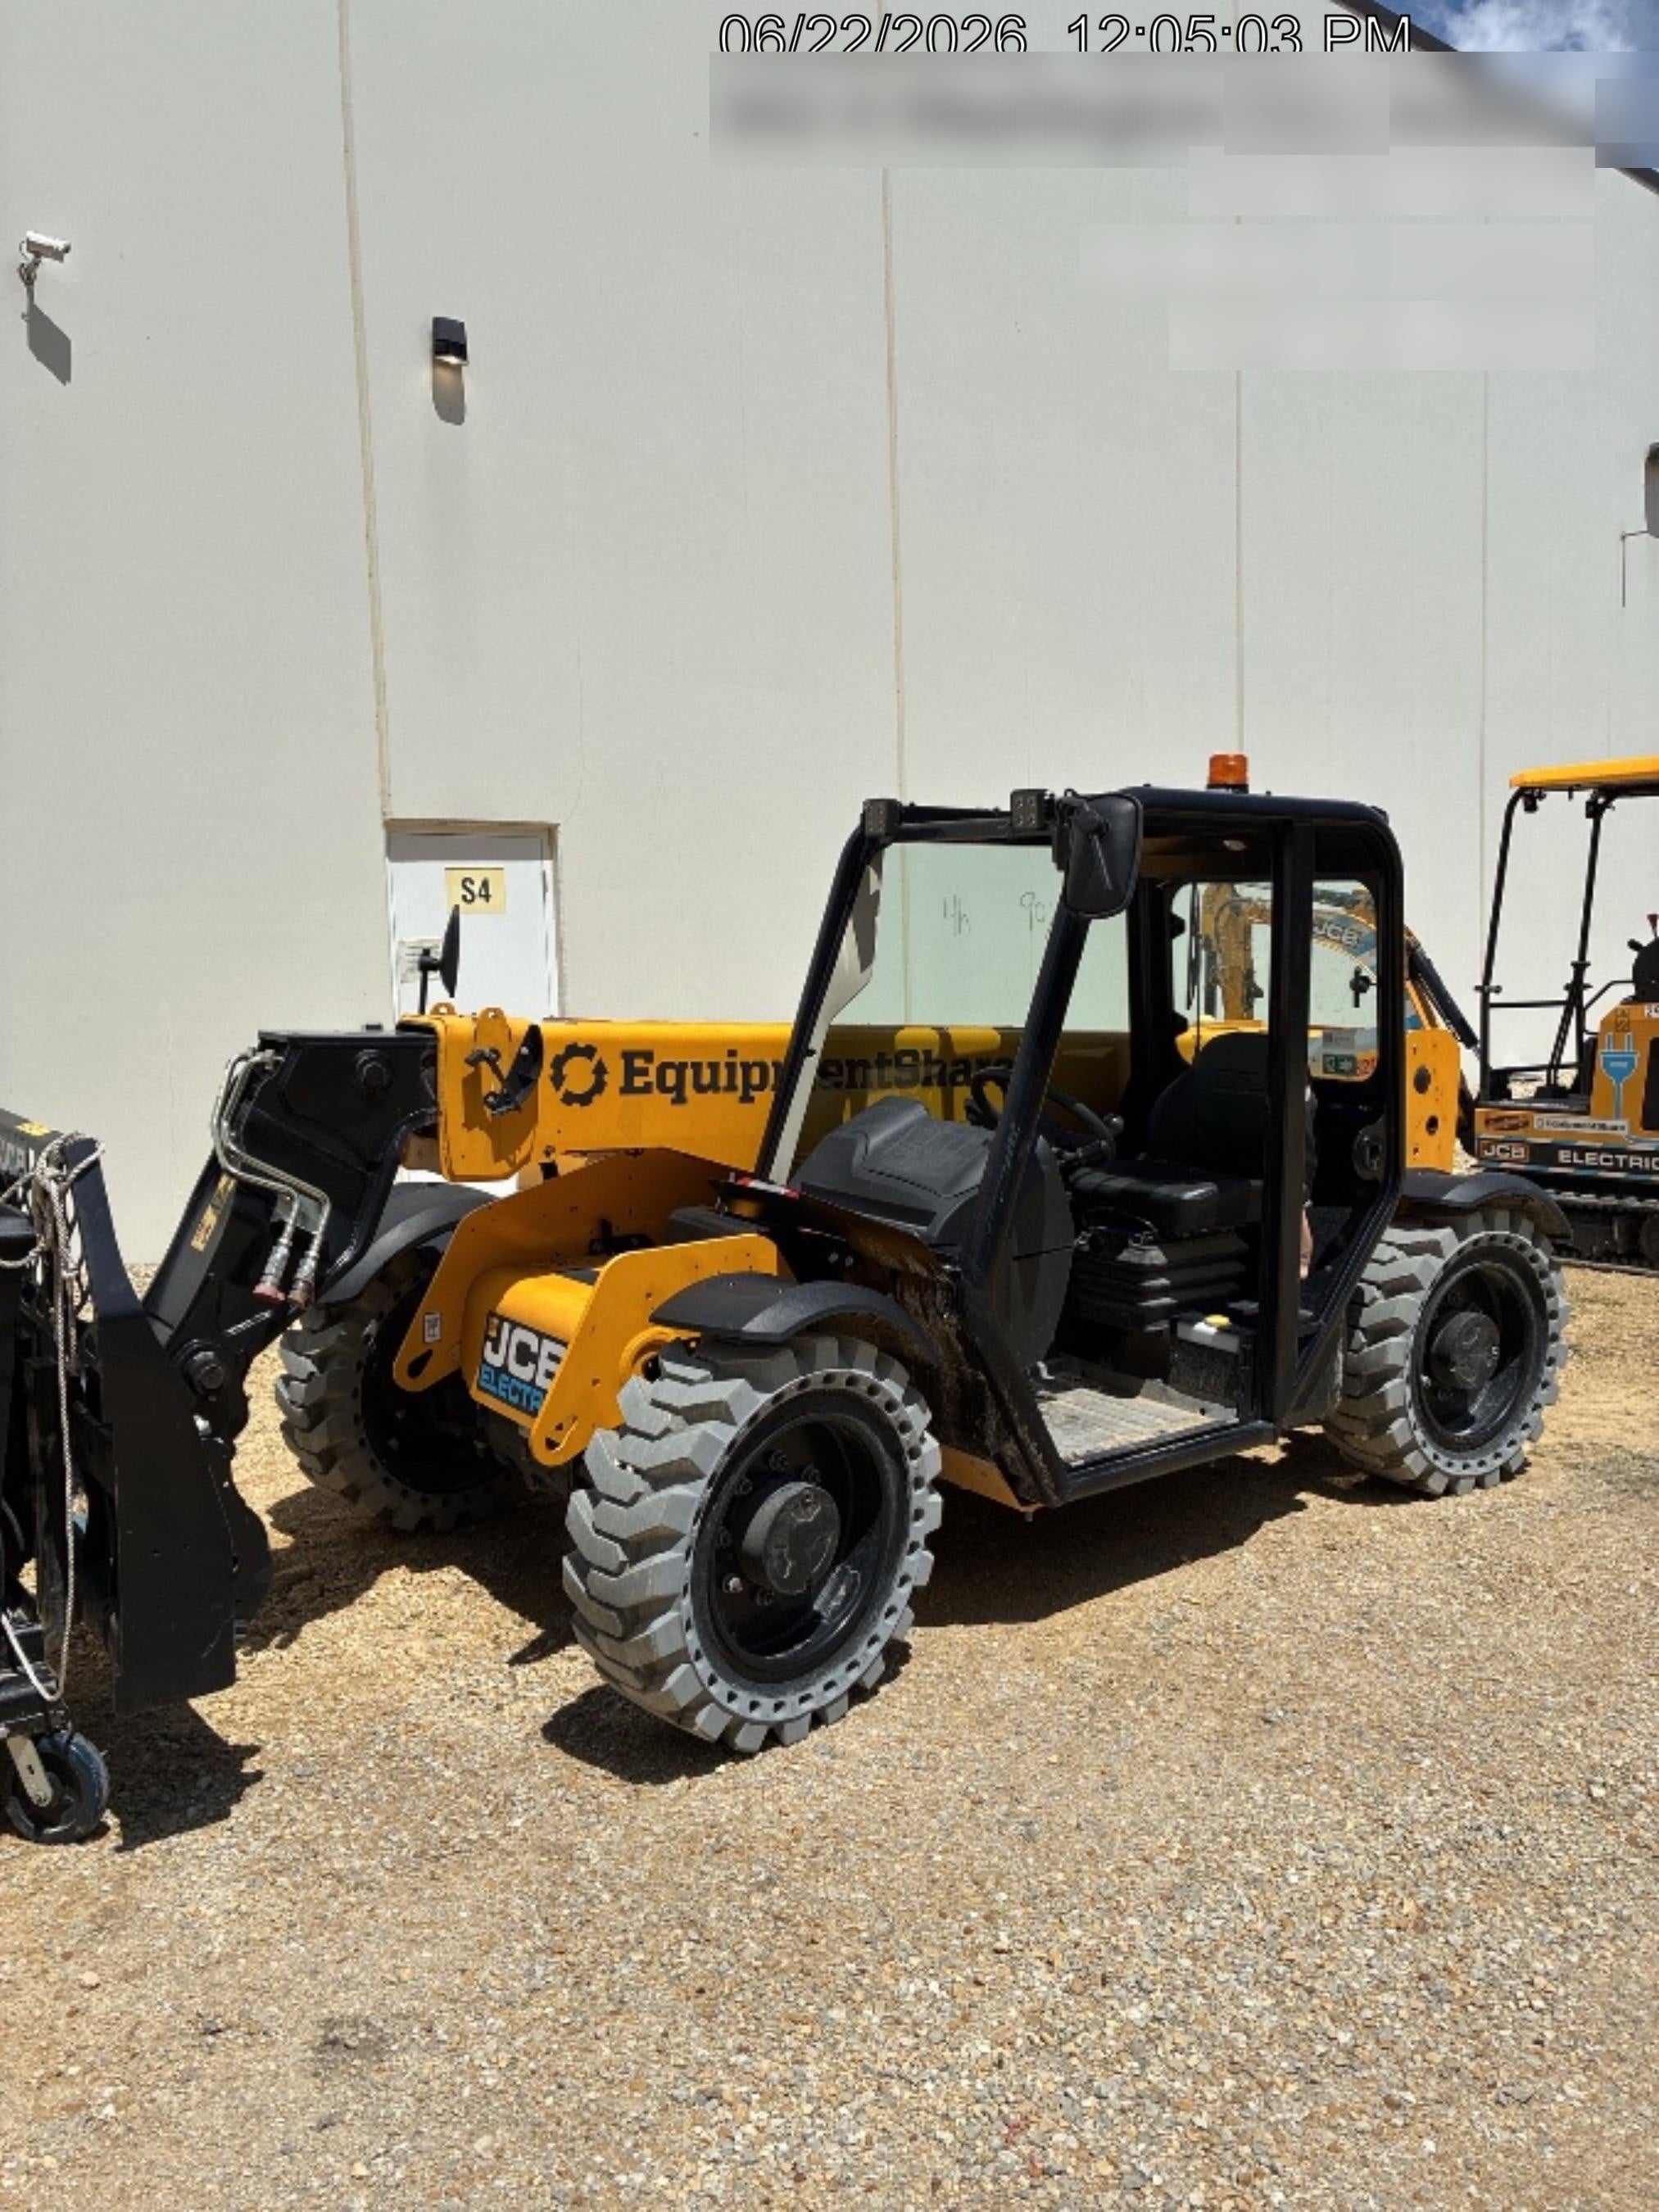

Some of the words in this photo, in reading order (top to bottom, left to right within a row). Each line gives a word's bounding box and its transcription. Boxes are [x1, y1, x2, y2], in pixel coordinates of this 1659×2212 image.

[461, 877, 492, 904] S4
[1484, 1144, 1525, 1159] JCB
[483, 1321, 567, 1390] JCB
